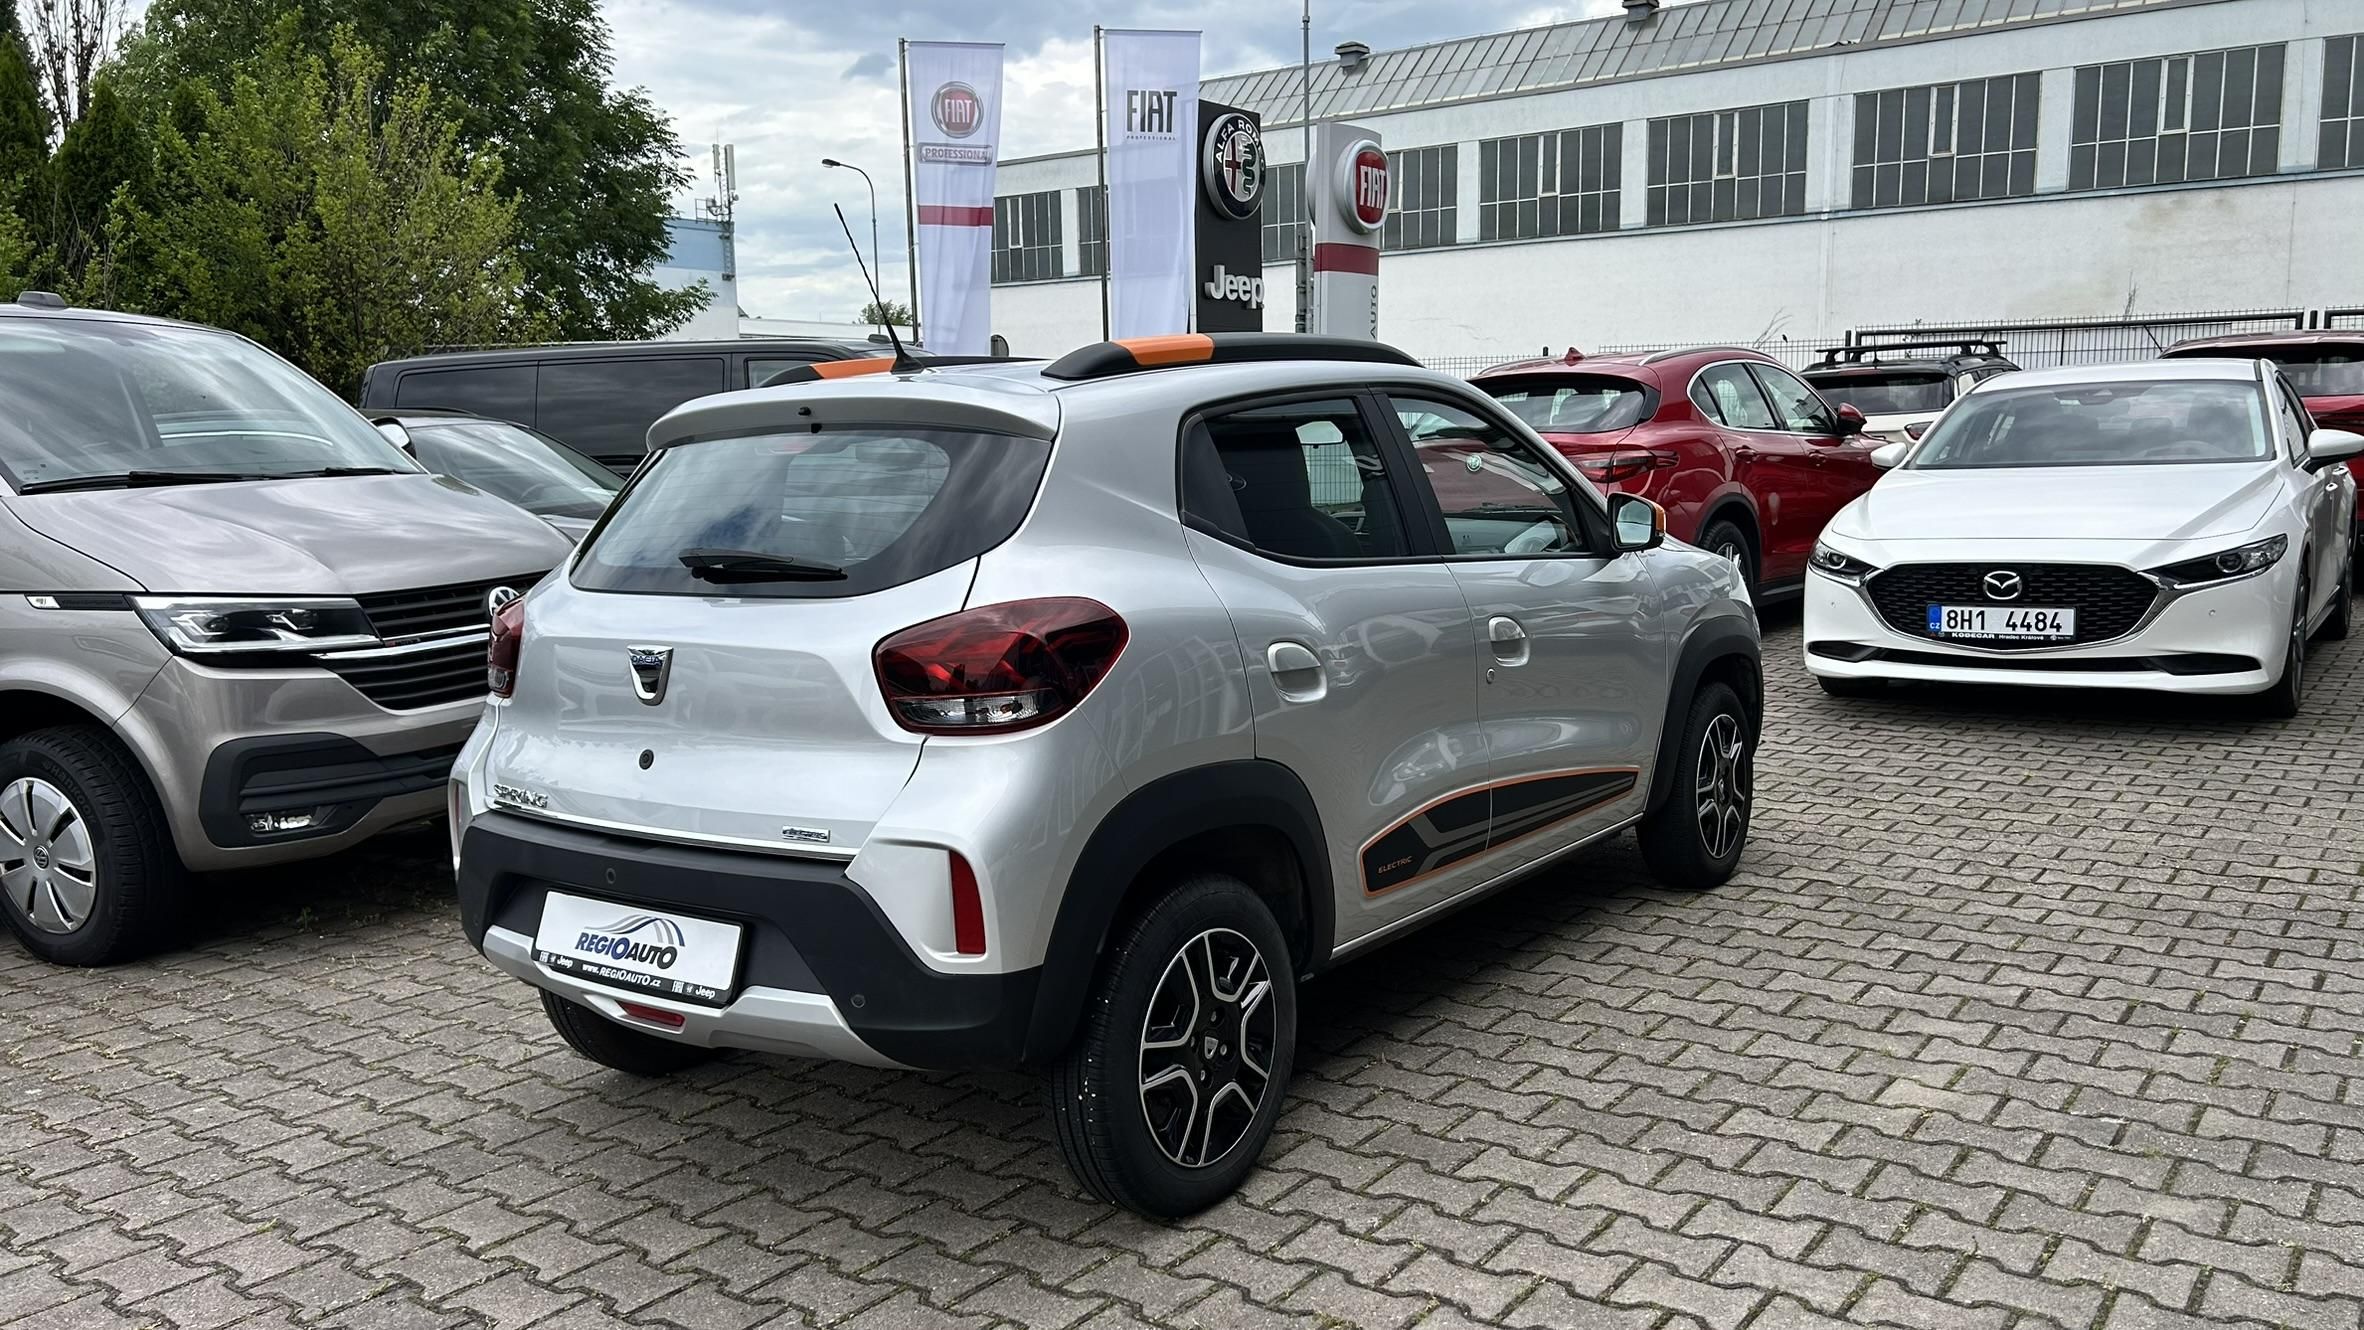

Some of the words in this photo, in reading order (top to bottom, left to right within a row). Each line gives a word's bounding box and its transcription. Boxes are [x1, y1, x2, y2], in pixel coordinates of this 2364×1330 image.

[944, 98, 973, 123] FIAT
[1126, 90, 1178, 133] FIAT
[1215, 123, 1235, 164] ALFA
[1360, 165, 1386, 209] FIAT
[1204, 264, 1265, 309] Jeep
[1369, 284, 1377, 339] AUTO
[1929, 622, 1941, 630] CZ
[1946, 609, 1986, 631] 8H1
[2005, 610, 2063, 633] 4484
[494, 784, 549, 808] SPRING
[1378, 855, 1412, 873] ELECTRIC
[574, 931, 678, 970] REGIOAUTO
[695, 985, 716, 1000] Jeep
